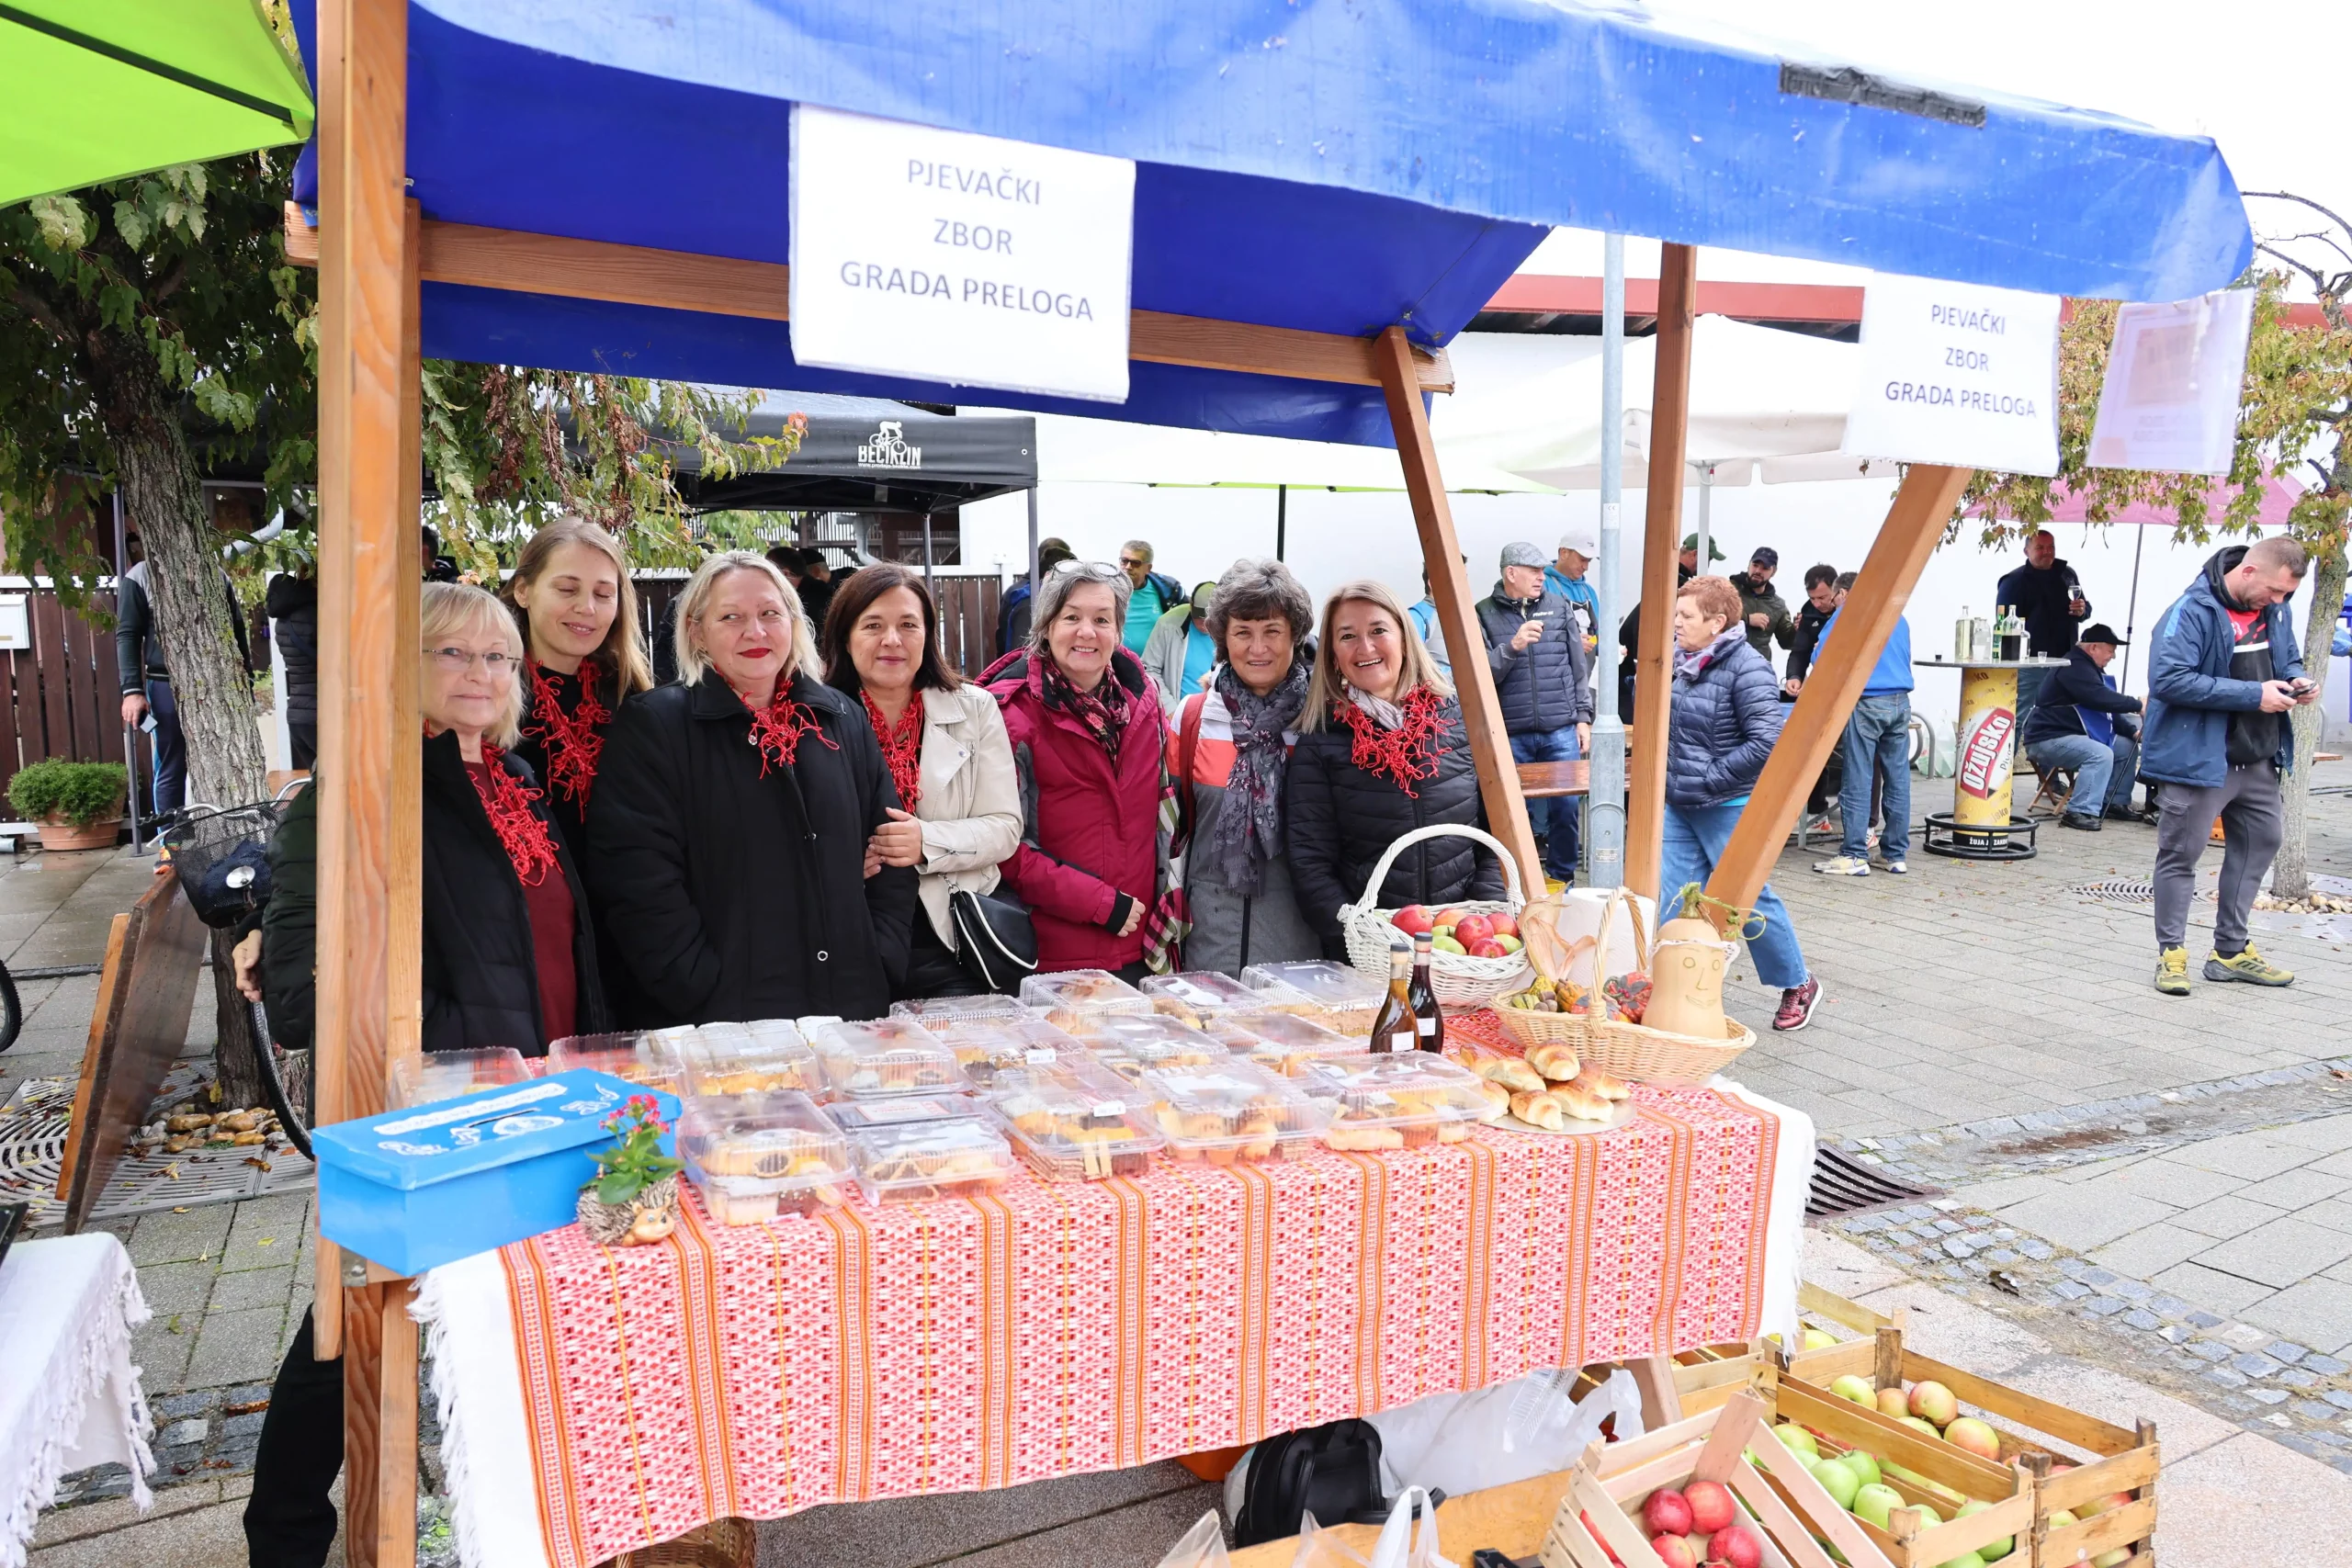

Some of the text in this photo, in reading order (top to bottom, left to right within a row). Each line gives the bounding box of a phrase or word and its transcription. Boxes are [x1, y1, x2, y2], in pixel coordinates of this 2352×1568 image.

[908, 159, 1040, 205] PJEVAČKI
[933, 219, 1012, 255] ZBOR
[840, 261, 1093, 321] GRADA PRELOGA
[1931, 303, 2007, 336] PJEVAČKI
[1945, 346, 1989, 372] ZBOR
[1884, 380, 2037, 418] GRADA PRELOGA
[858, 446, 922, 467] BECIKLIN
[1969, 836, 1985, 846] ŽUJA
